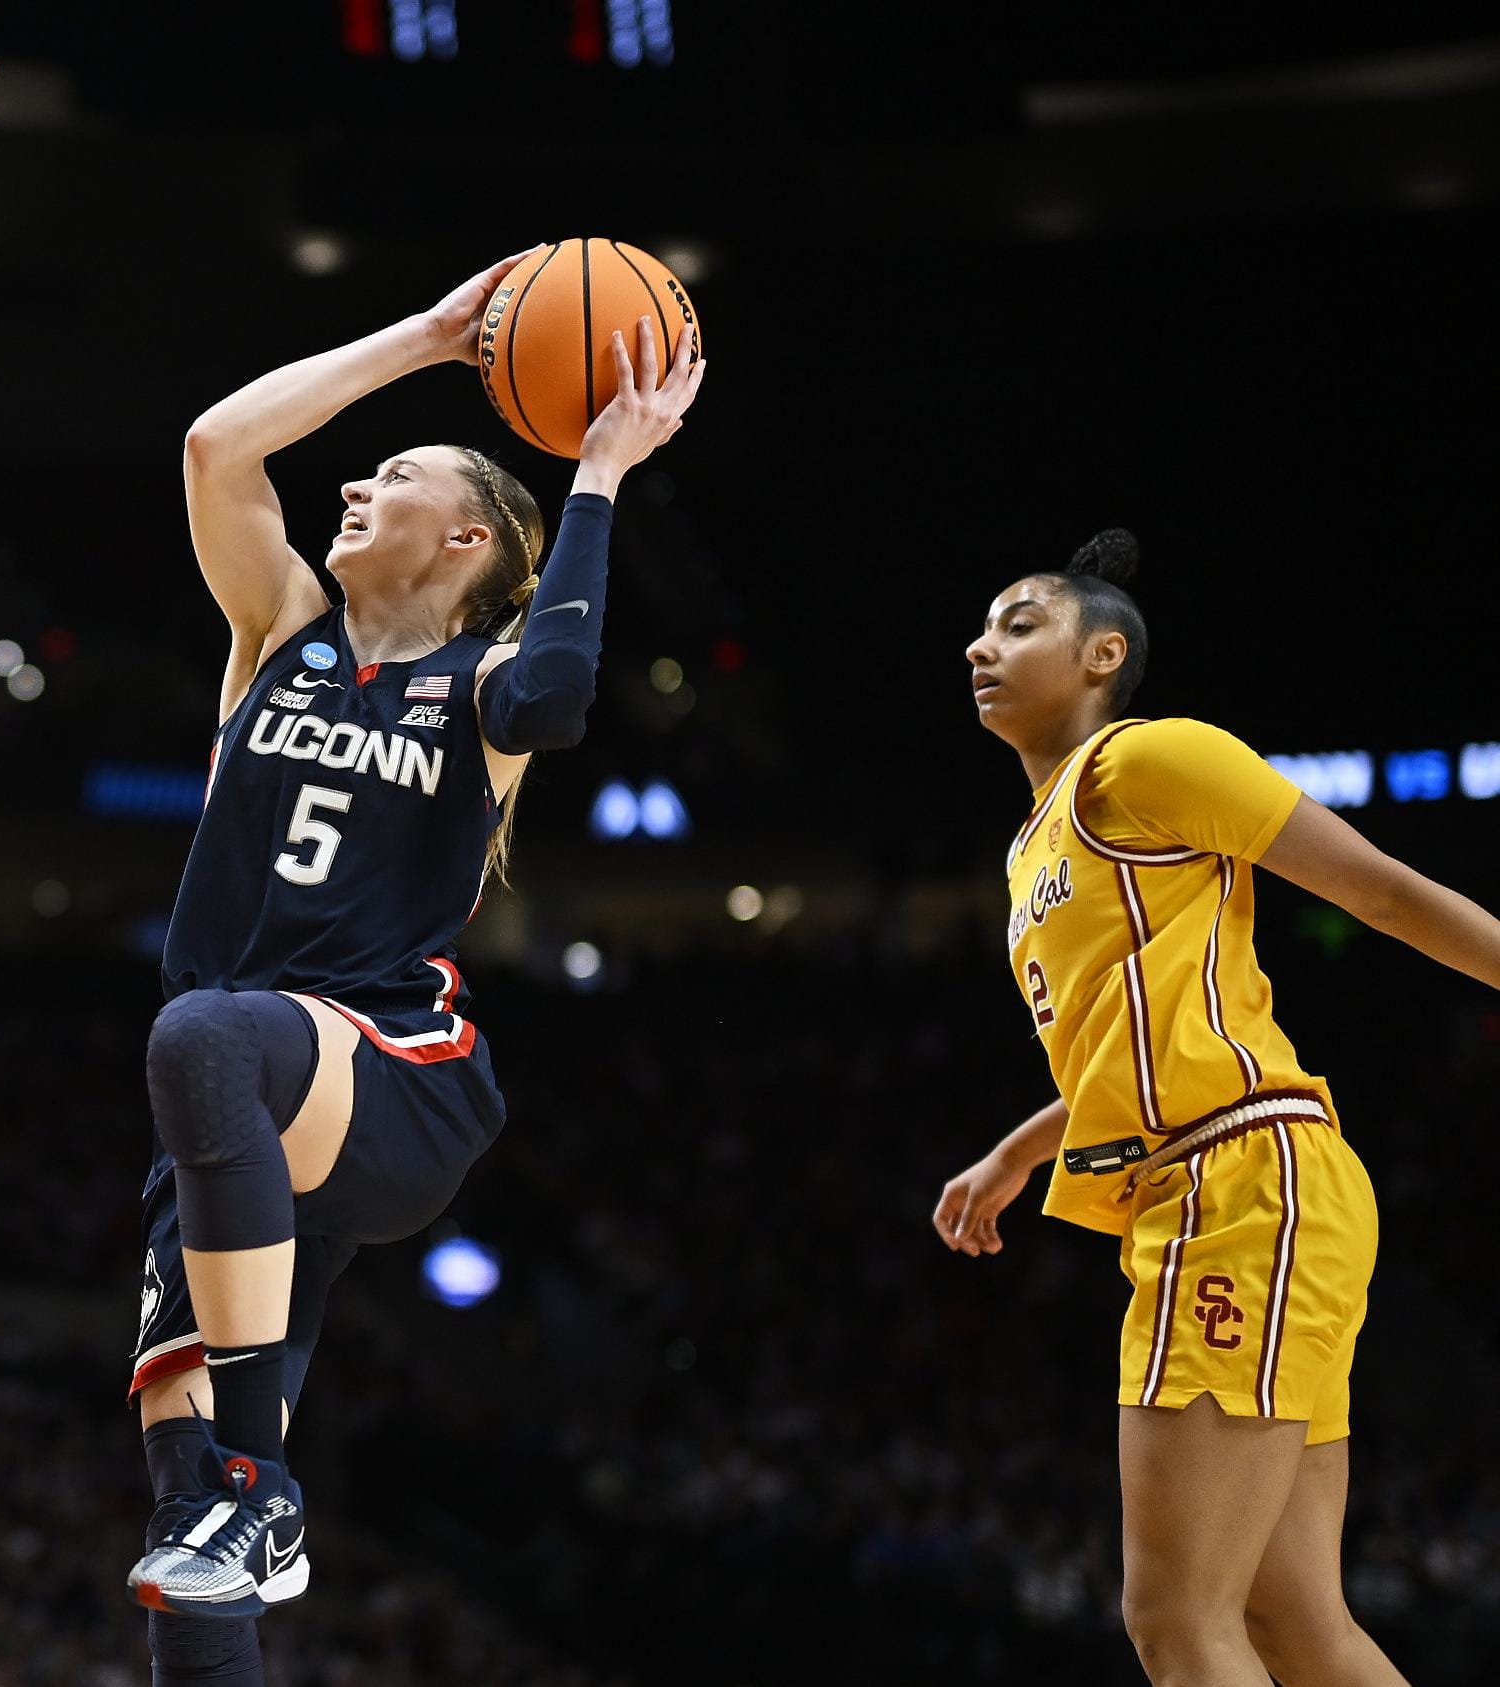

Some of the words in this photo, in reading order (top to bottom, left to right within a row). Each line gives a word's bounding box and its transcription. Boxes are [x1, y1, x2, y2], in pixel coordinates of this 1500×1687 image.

[305, 650, 333, 667] NCAA
[402, 713, 450, 726] EAST
[409, 705, 443, 716] BIG
[247, 708, 444, 797] UCONN
[274, 783, 353, 886] 5
[1030, 857, 1073, 926] Cal
[1125, 1145, 1141, 1157] 46
[1194, 1274, 1245, 1350] SC
